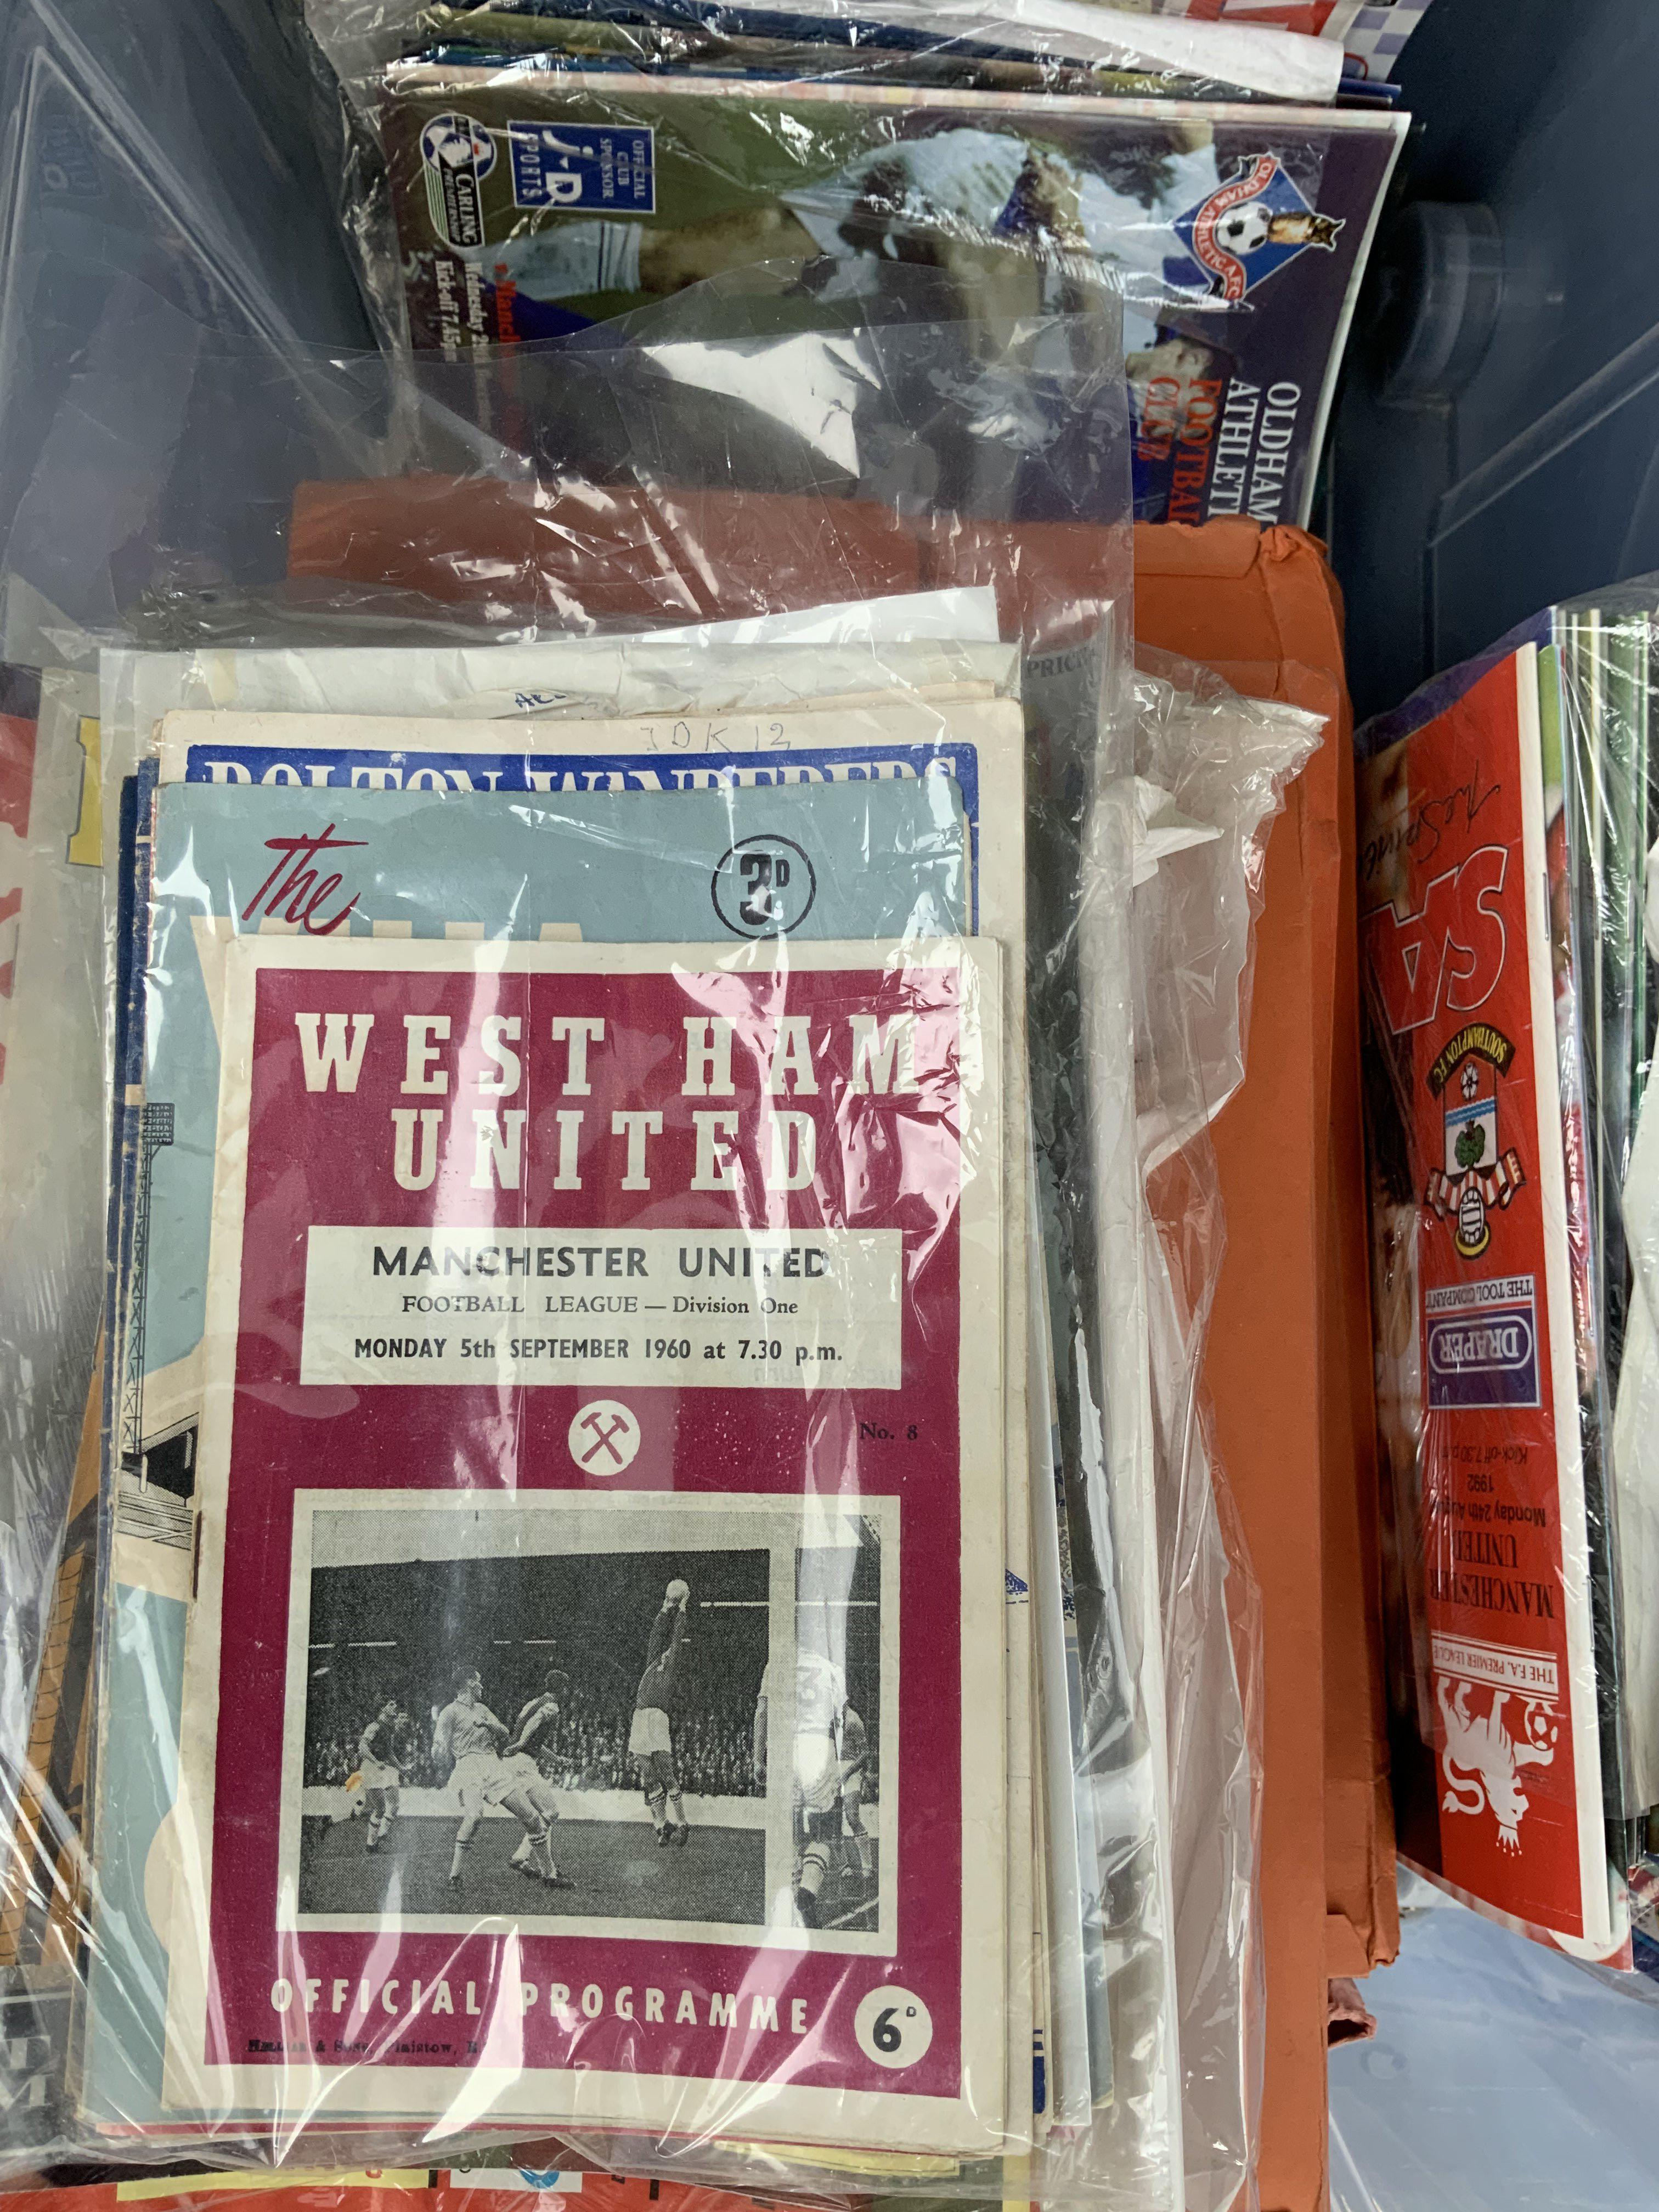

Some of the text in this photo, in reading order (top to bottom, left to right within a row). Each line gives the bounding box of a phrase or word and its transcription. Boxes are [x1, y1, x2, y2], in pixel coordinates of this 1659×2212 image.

[520, 133, 542, 200] SPORTS
[600, 137, 615, 199] SPONSOR
[631, 140, 646, 199] OFFICIAL
[455, 173, 478, 244] CARLING
[1136, 376, 1181, 462] CLUB
[1167, 377, 1223, 527] FOOTBAL
[1206, 377, 1261, 517] ATHLETI
[1247, 381, 1301, 524] OLDHAM
[241, 823, 368, 935] The
[295, 1012, 919, 1097] WEST HAM
[1446, 1026, 1507, 1064] SOUTHAMPTON
[391, 1108, 817, 1191] UNITED
[373, 1245, 829, 1278] MANCHESTER UNITED
[402, 1295, 526, 1313] FOOTBALL
[545, 1295, 637, 1313] LEAGUE
[672, 1296, 749, 1313] Division
[760, 1296, 798, 1314] One
[1426, 1279, 1533, 1308] THE TOOL COMPANY
[355, 1338, 843, 1365] MONDAY 5th SEPTEMBER 1960 at 7.30 p.m.
[1438, 1326, 1519, 1363] DRAPER
[859, 1422, 918, 1441] No. 8
[1484, 1446, 1528, 1465] Kick-off
[1466, 1474, 1495, 1493] 1992
[1468, 1503, 1492, 1523] 24th
[1493, 1500, 1547, 1527] Monday
[1452, 1531, 1517, 1567] UNITED
[1429, 1569, 1554, 1618] MANCHESTER
[1432, 1645, 1555, 1685] THE F.A. PREMIER LEAGUE
[270, 1978, 809, 2034] OFFICIAL PROGRAMME
